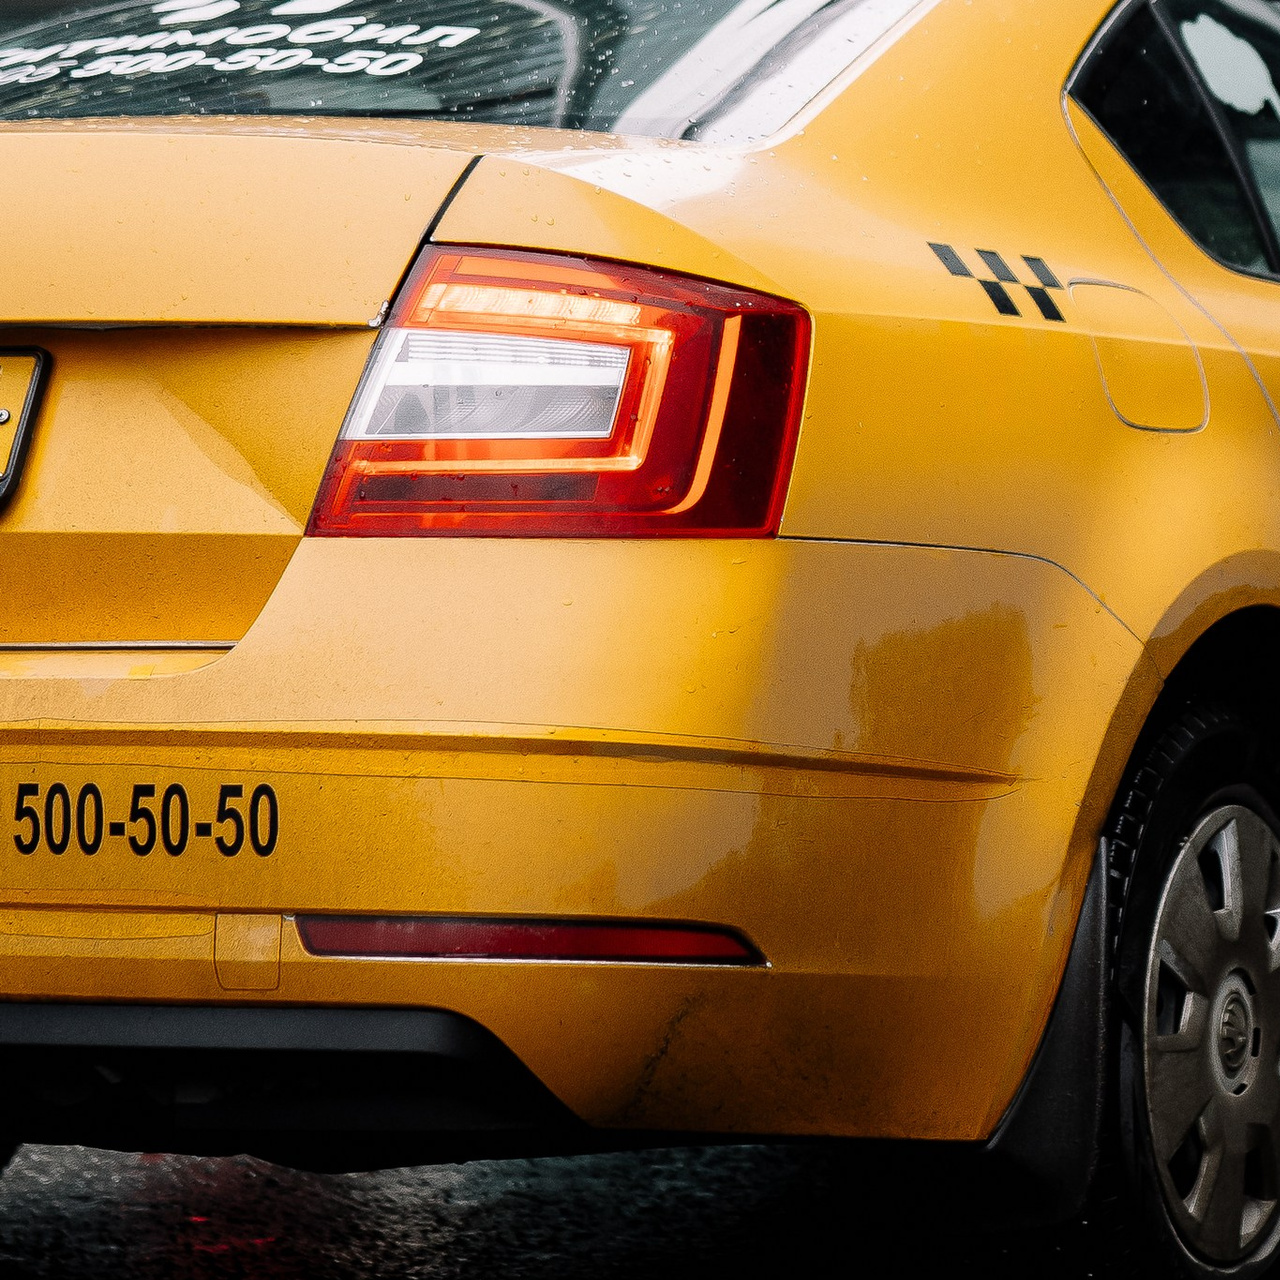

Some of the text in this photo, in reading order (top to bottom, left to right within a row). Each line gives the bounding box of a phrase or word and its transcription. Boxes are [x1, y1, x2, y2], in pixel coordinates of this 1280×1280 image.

[0, 16, 481, 67] итимобил
[70, 48, 423, 78] 500-50-50
[13, 782, 279, 857] 500-50-50
